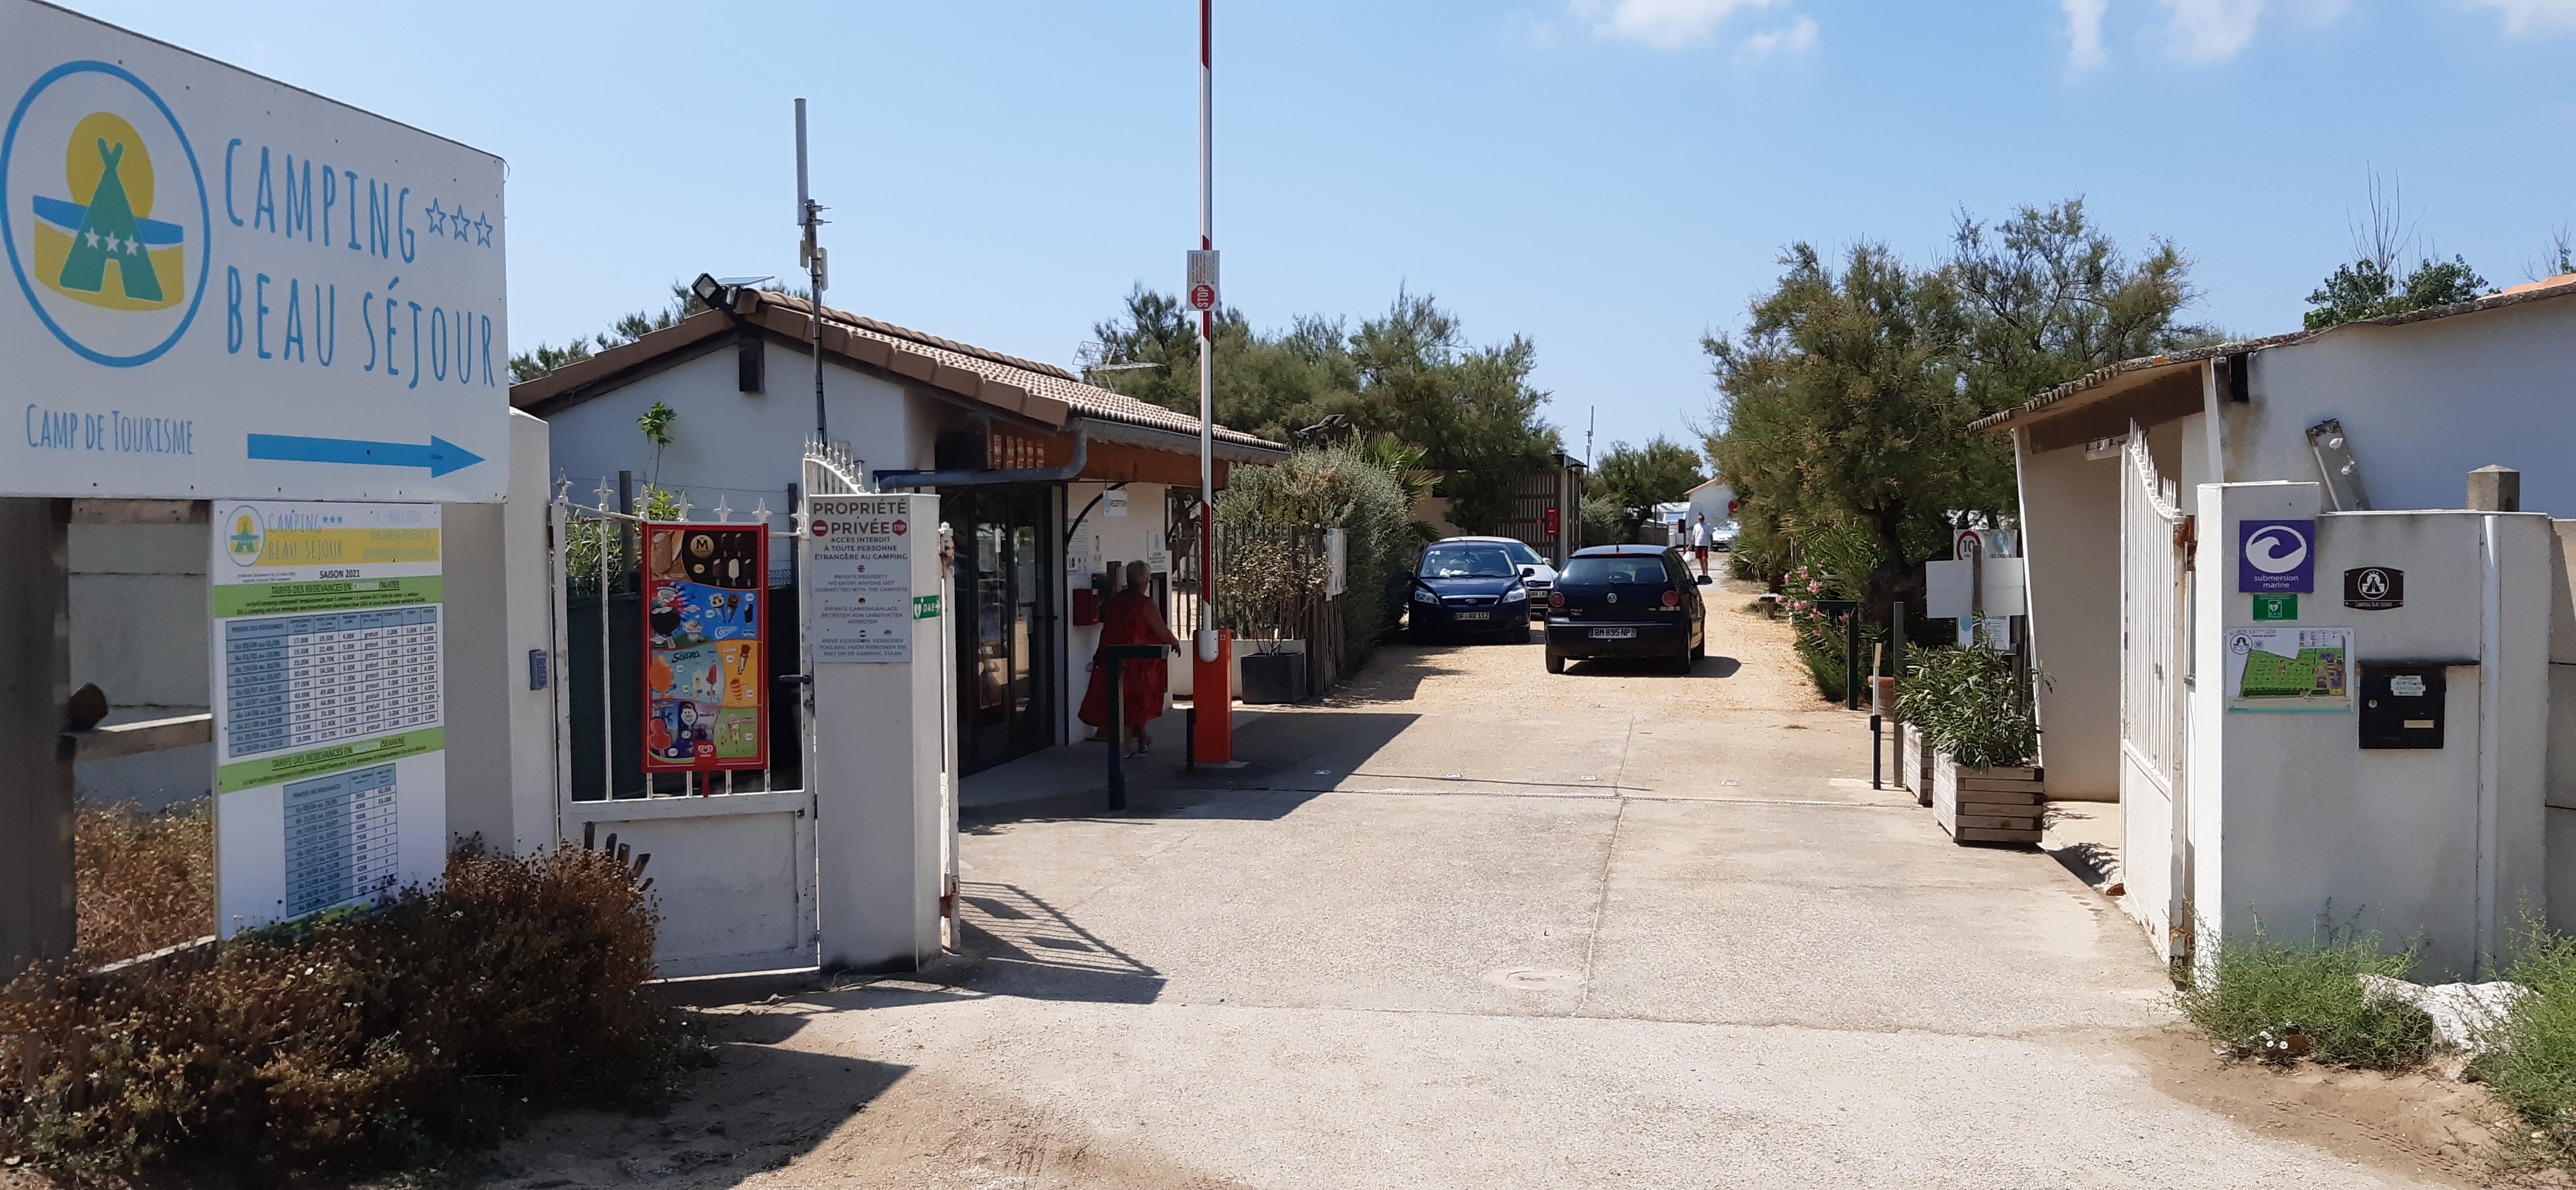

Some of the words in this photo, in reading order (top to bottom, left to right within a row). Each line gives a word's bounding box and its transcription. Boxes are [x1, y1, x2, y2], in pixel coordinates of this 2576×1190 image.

[225, 138, 415, 264] CAMPING
[1197, 286, 1209, 308] STOP
[228, 265, 335, 367] BEAU
[363, 276, 495, 389] SÉJOUR
[26, 404, 77, 450] CAMP
[112, 410, 194, 456] TOURISME
[813, 499, 907, 515] PROPRIÉTÉ
[268, 513, 321, 533] CAMPING
[831, 518, 890, 535] PRIVÉE
[268, 540, 297, 560] BEAU
[305, 536, 343, 560] SÉJOUR
[696, 540, 709, 550] M
[320, 570, 343, 579] SAISON
[345, 569, 360, 578] 2021
[923, 603, 935, 612] DAE
